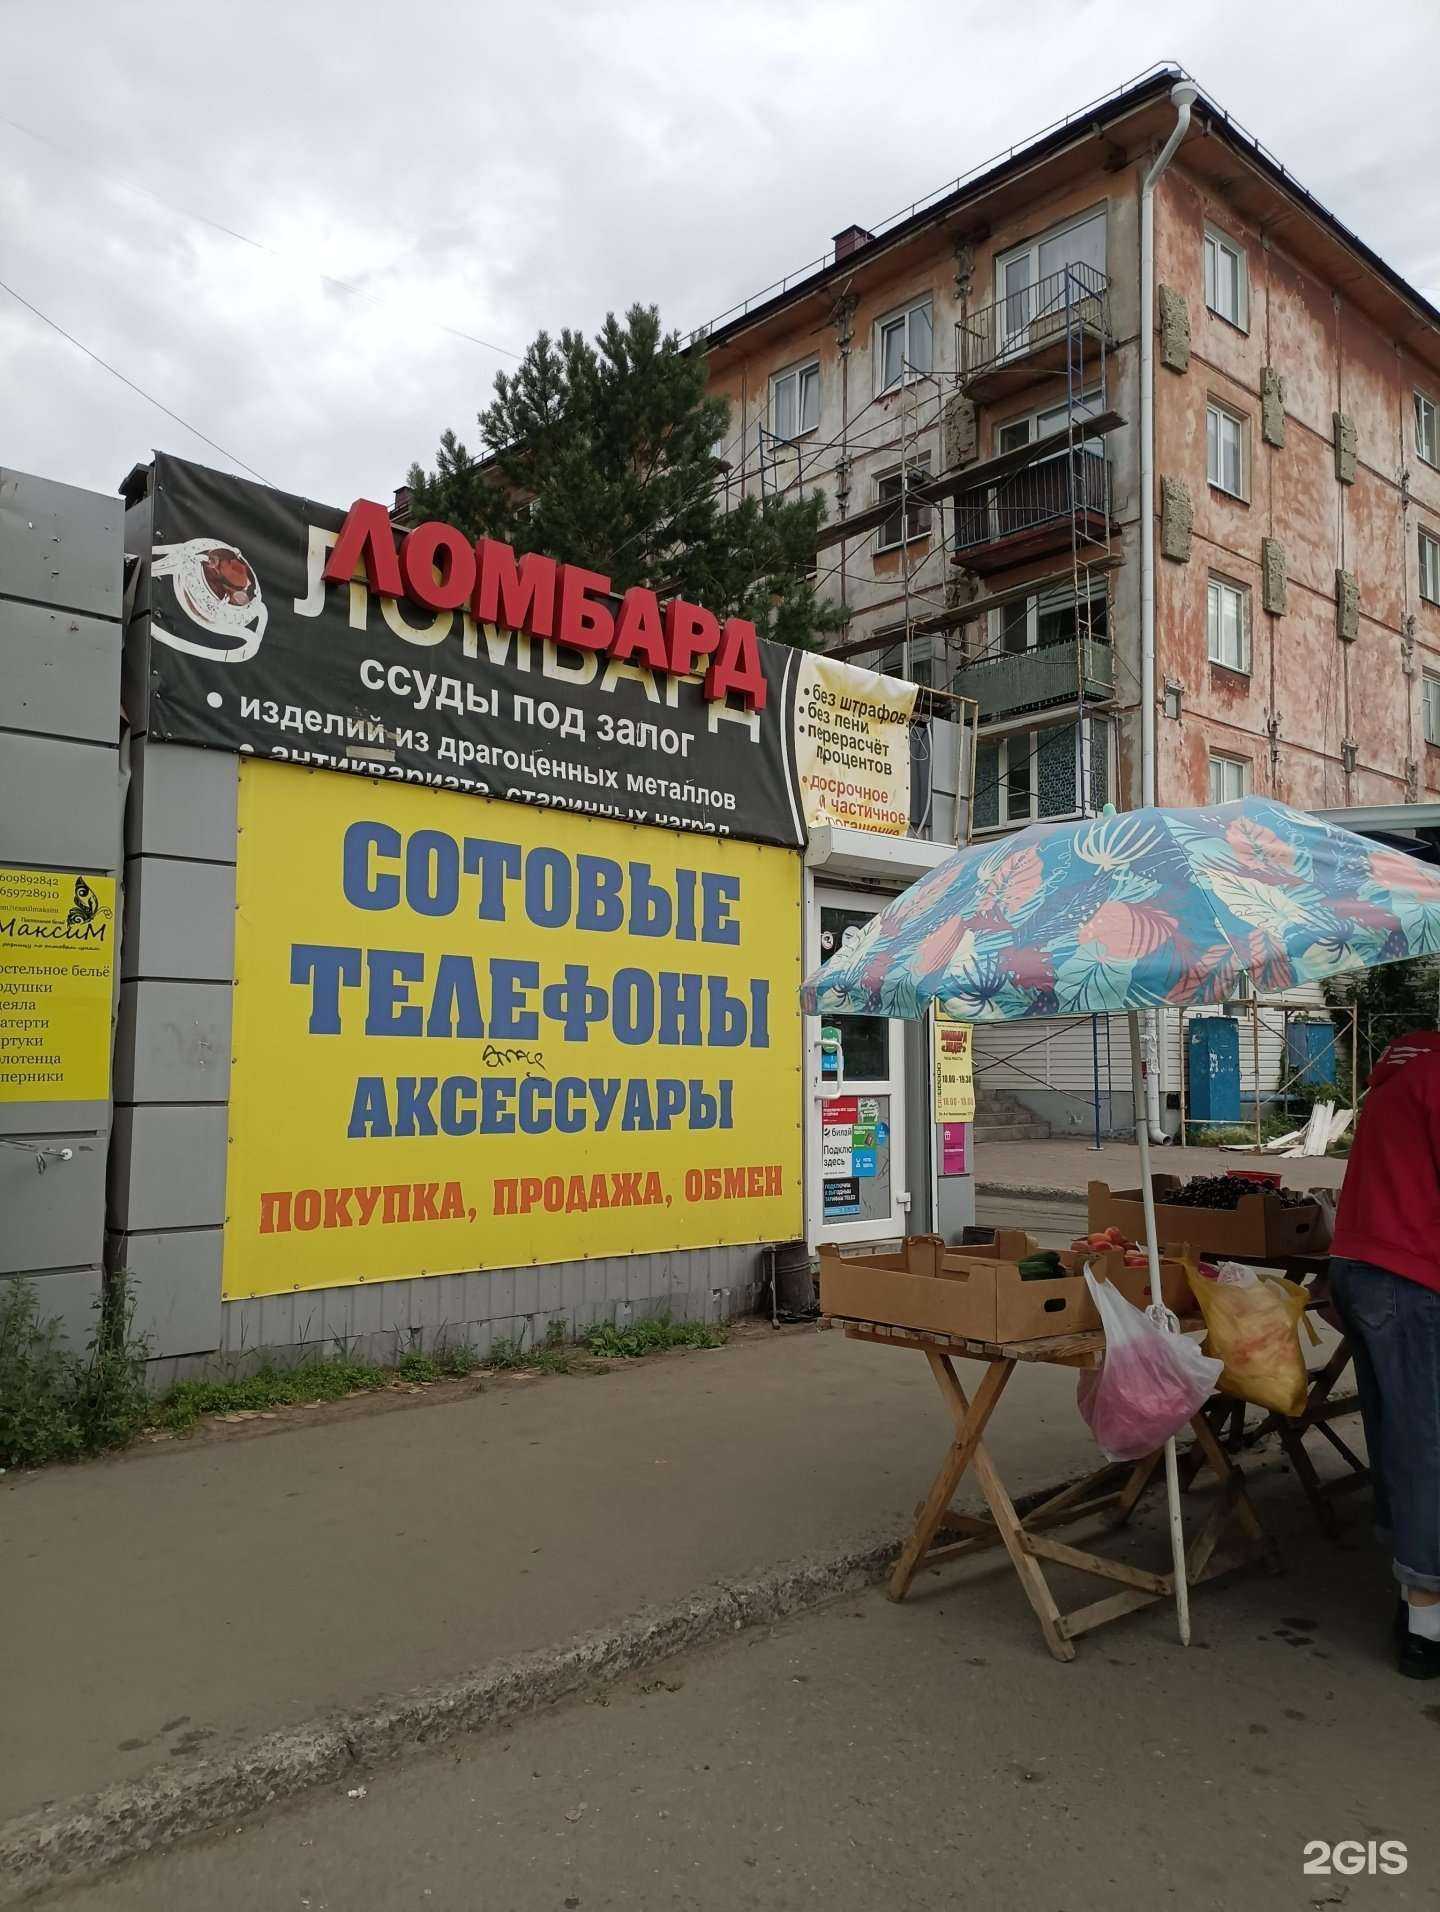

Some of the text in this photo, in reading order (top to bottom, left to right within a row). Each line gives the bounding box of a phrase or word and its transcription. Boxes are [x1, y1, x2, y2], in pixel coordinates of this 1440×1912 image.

[322, 498, 768, 711] ЛОМБАРД
[359, 658, 696, 758] ссуды под залог
[807, 702, 870, 735] без пени
[812, 684, 908, 726] без штрафов
[239, 694, 737, 812] изделий из драгоценных металлов
[807, 725, 890, 757] перерасчёт
[816, 745, 893, 776] процентов
[810, 775, 889, 804] досрочное
[830, 798, 907, 825] частичное
[342, 820, 741, 946] СОТОВЫЕ
[72, 964, 110, 978] бельё
[0, 1001, 37, 1013] еяла
[289, 943, 770, 1048] ТЕЛЕФОНЫ
[0, 1055, 61, 1066] лотенца
[346, 1075, 734, 1139] АКСЕССУАРЫ
[258, 1165, 783, 1234] ПОКУПКА, ПРОДАЖА, ОБМЕН
